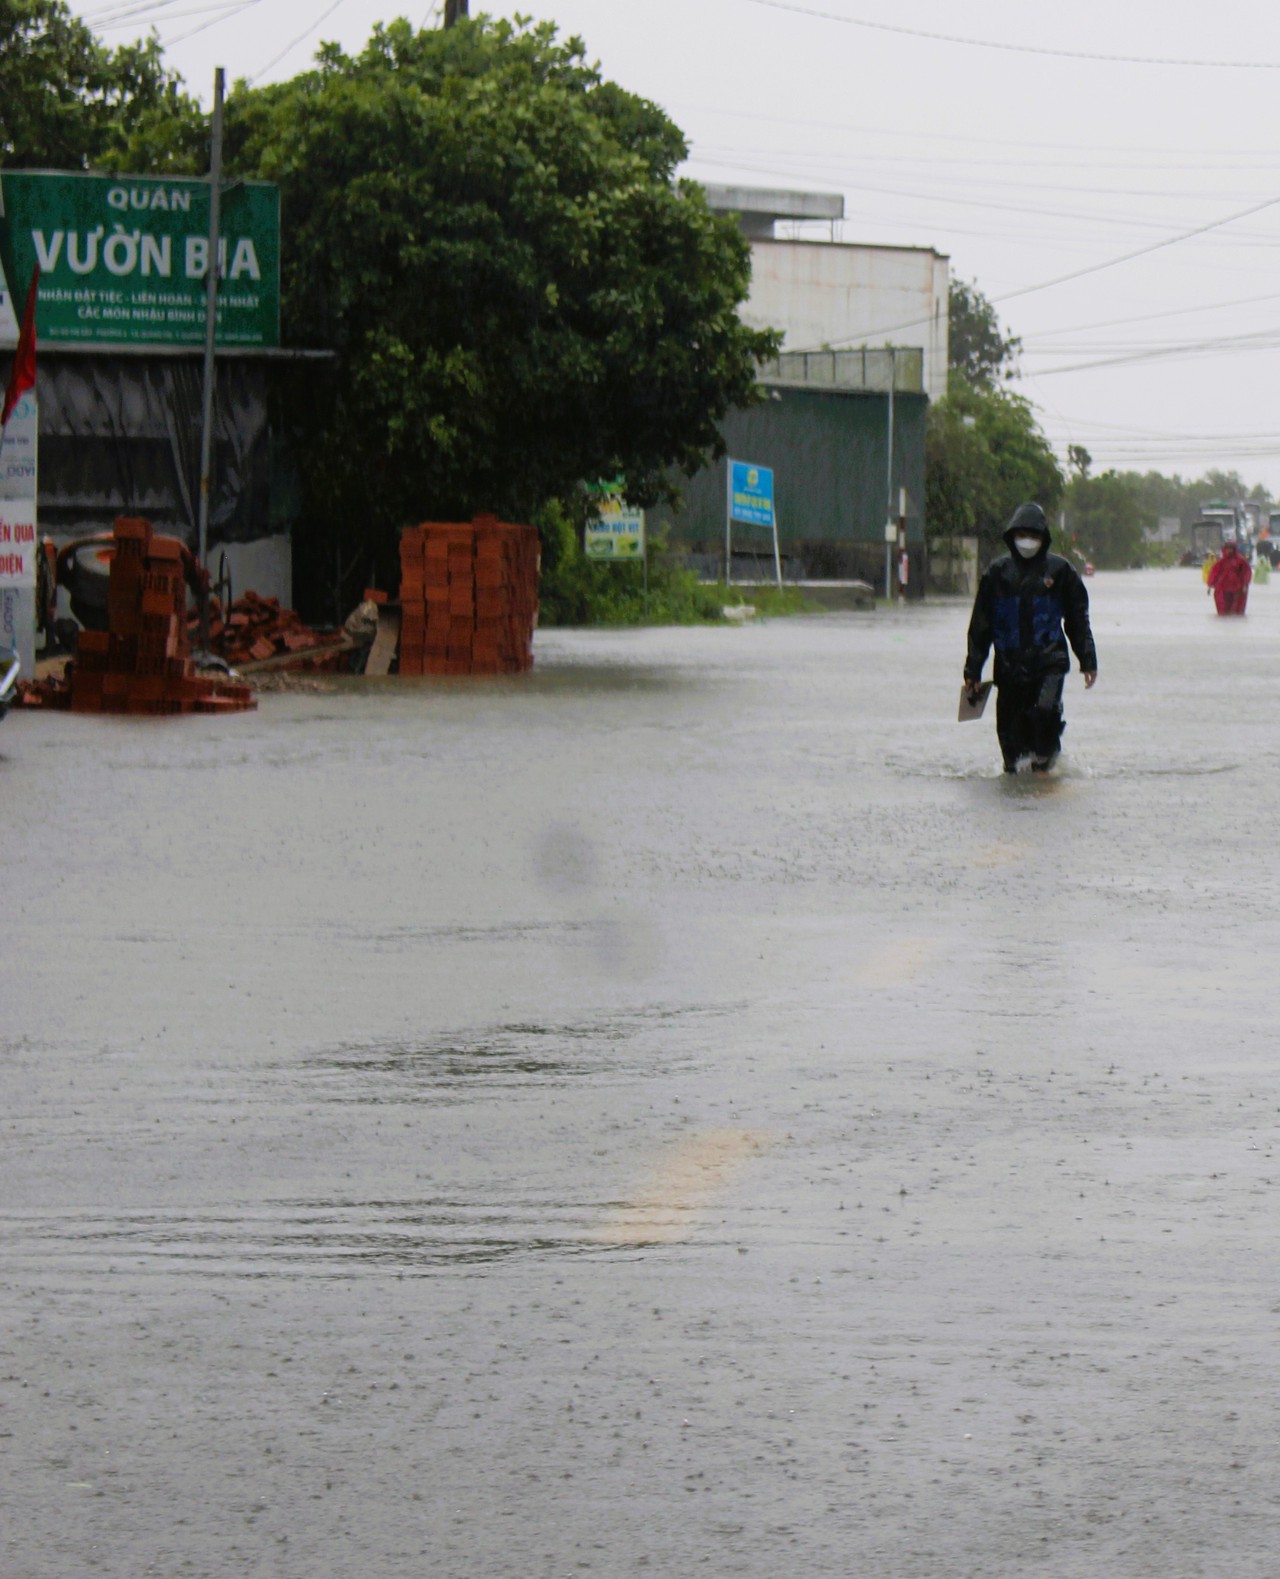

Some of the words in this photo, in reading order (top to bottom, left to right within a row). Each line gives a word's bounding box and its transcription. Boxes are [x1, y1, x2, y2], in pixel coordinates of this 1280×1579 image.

[108, 184, 190, 211] QUÁN
[32, 224, 171, 277] VƯỜN
[185, 236, 260, 280] BIA
